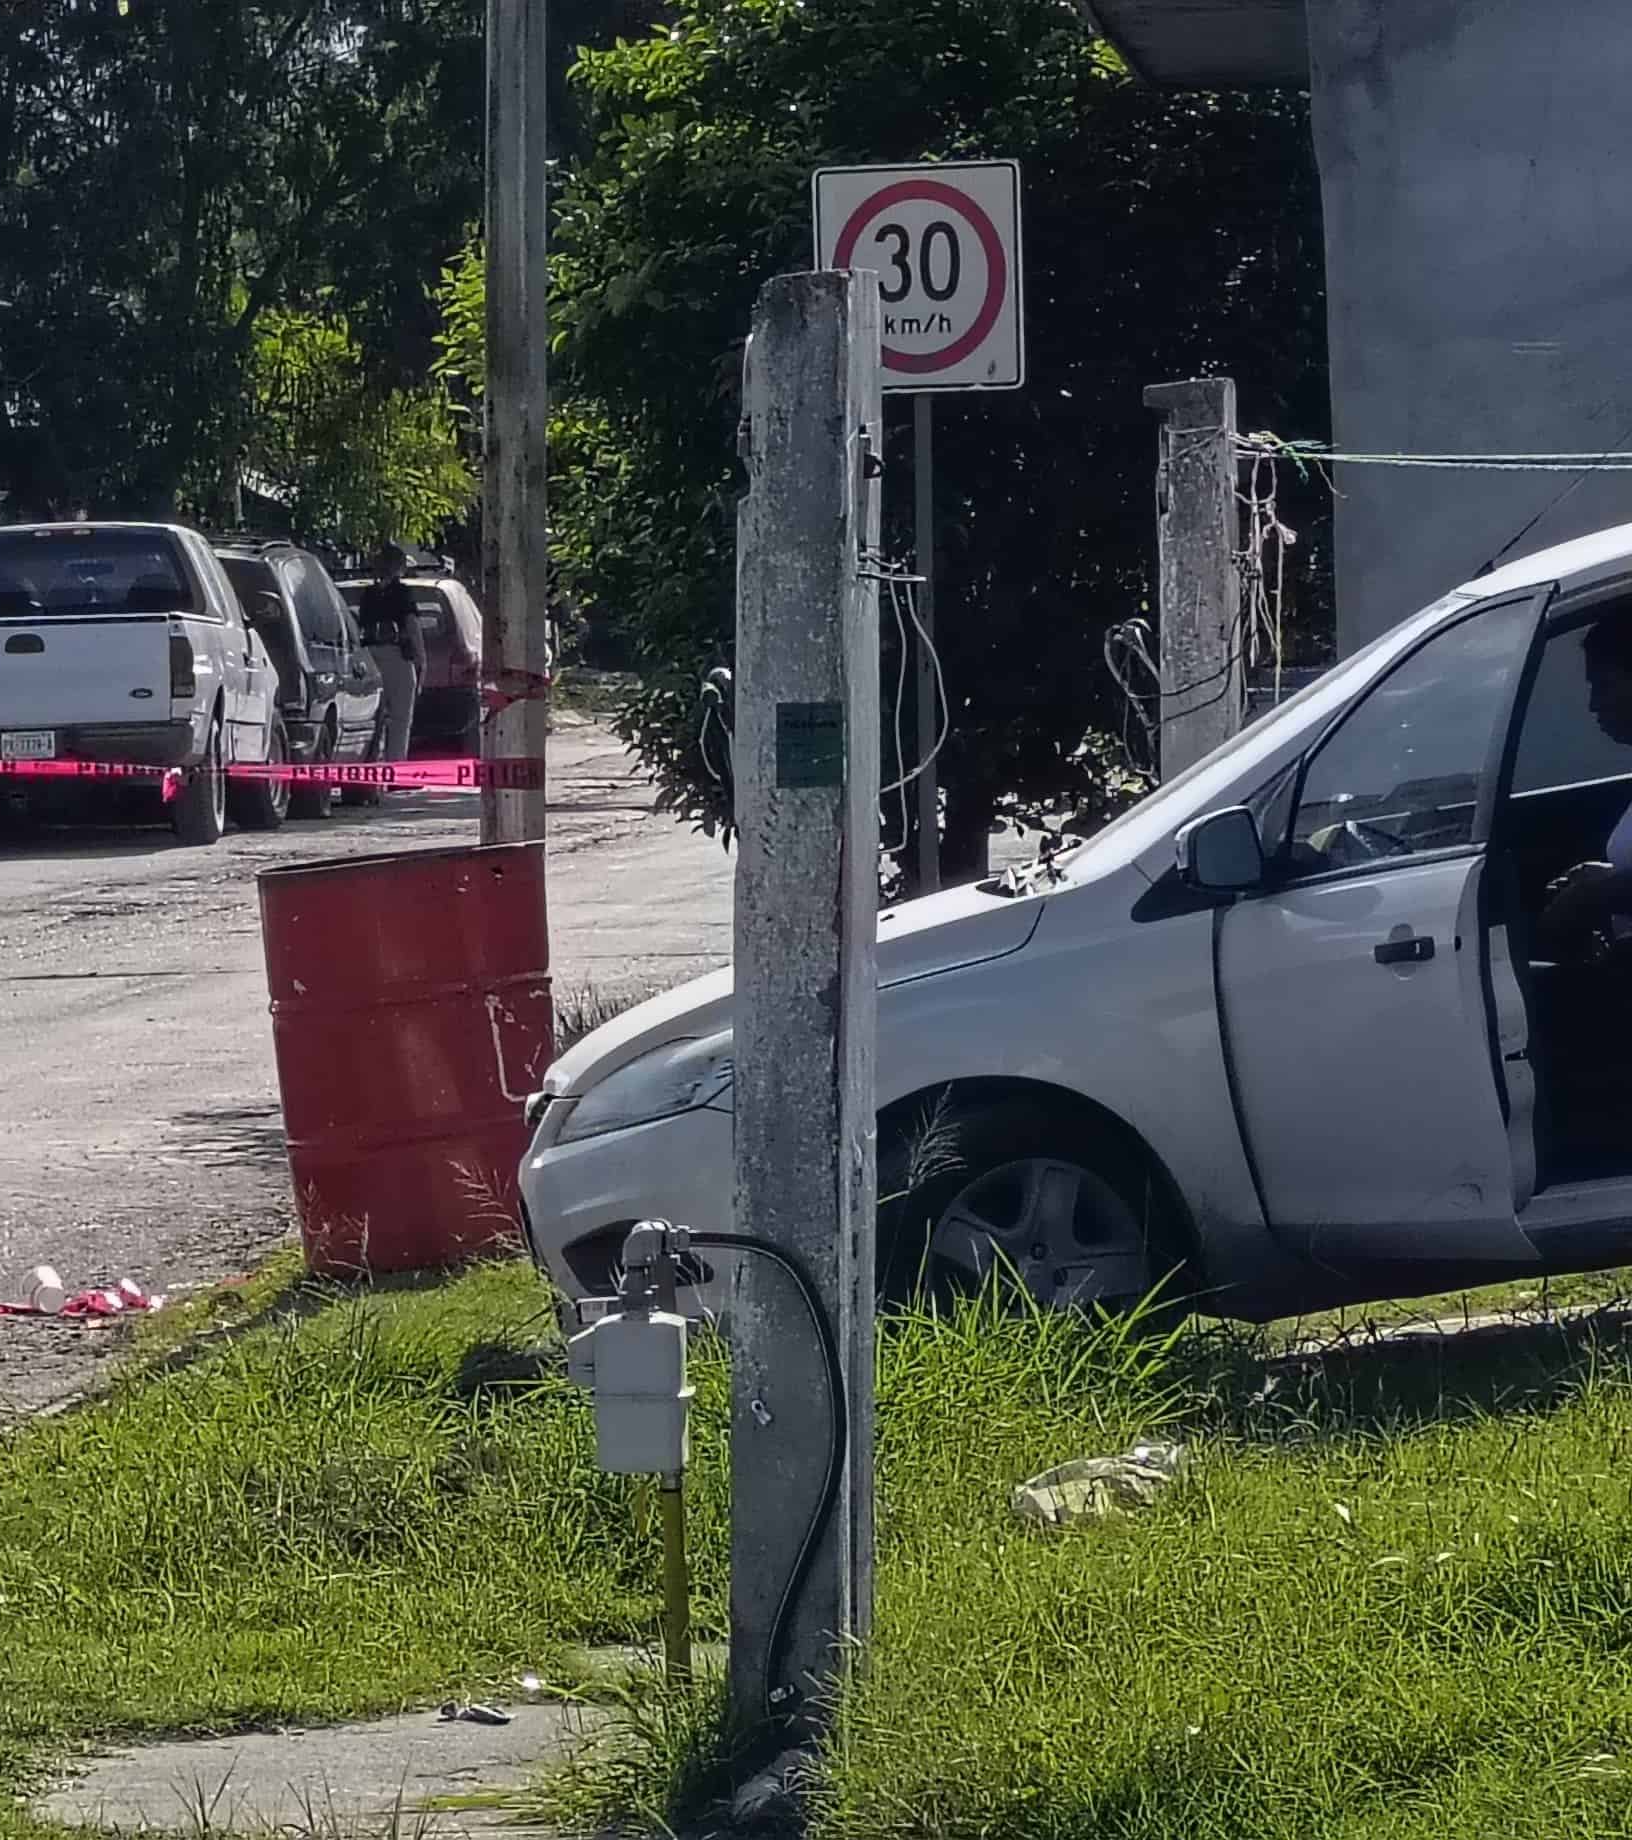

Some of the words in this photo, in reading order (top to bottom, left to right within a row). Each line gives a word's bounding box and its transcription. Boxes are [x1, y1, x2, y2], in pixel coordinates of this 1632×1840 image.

[874, 221, 961, 303] 30
[884, 313, 952, 335] km/h
[292, 765, 396, 784] PELIGRO
[457, 763, 545, 786] PELIGR
